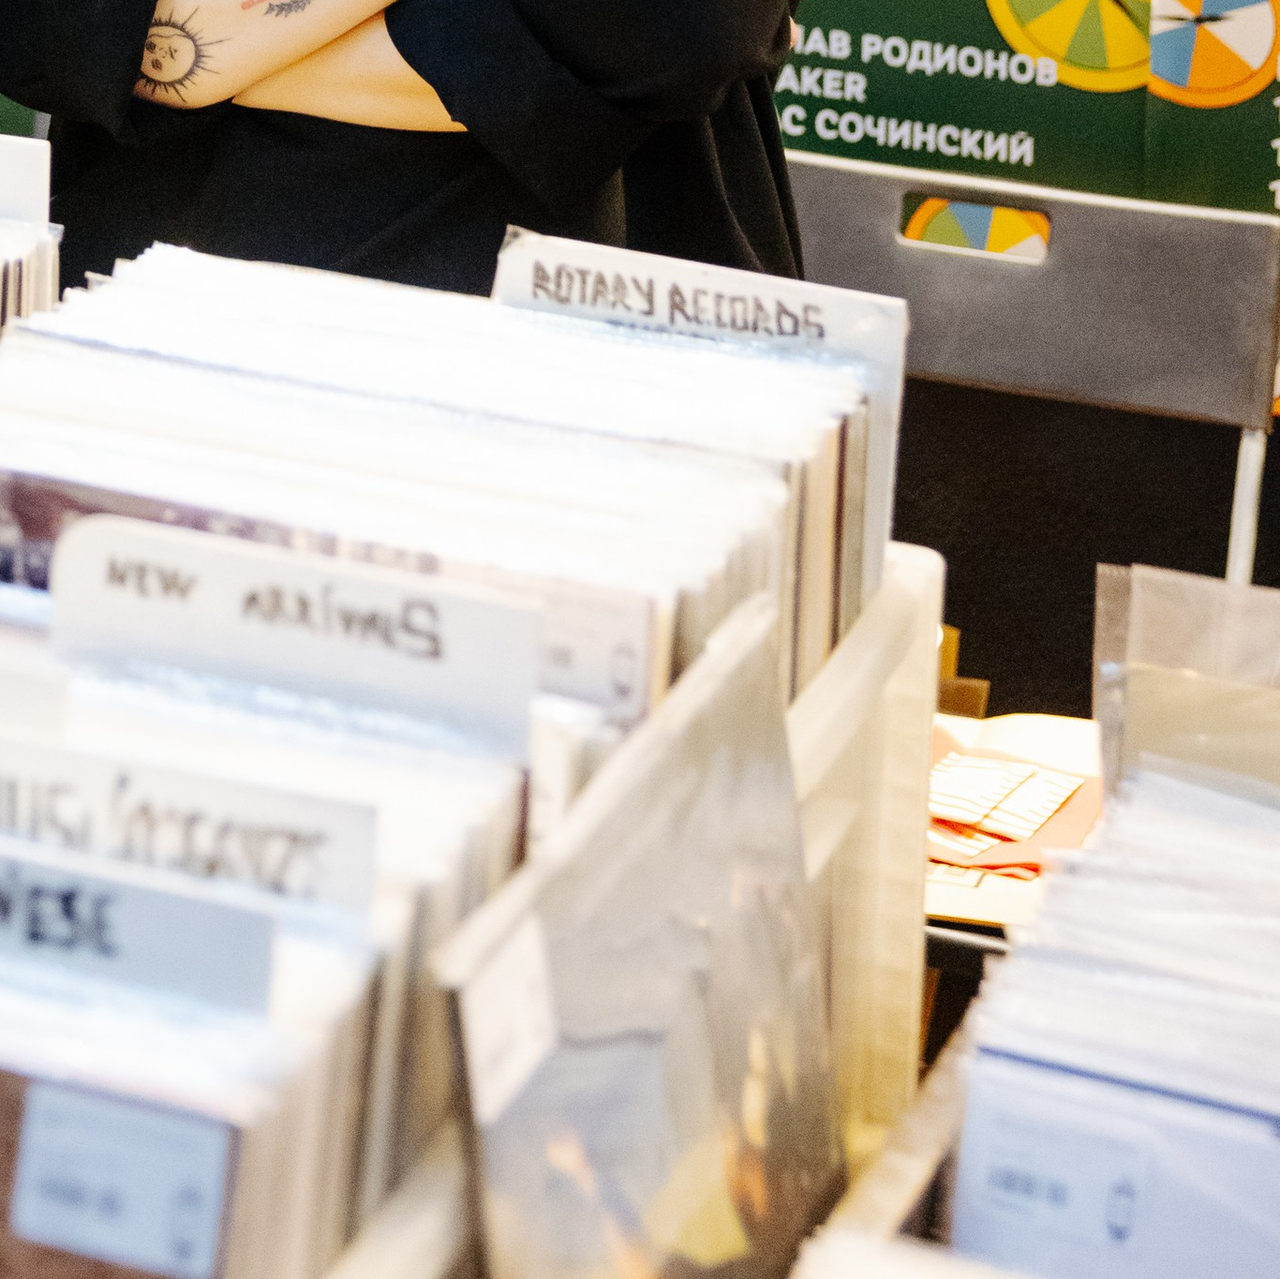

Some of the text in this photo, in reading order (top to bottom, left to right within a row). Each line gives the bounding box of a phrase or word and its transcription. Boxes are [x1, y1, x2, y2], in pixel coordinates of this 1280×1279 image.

[860, 32, 1059, 88] РОДИОНОВ
[814, 108, 1036, 167] СОЧИНСКИЙ
[531, 259, 827, 341] ROTARY RECORDS
[104, 555, 199, 602] NEW
